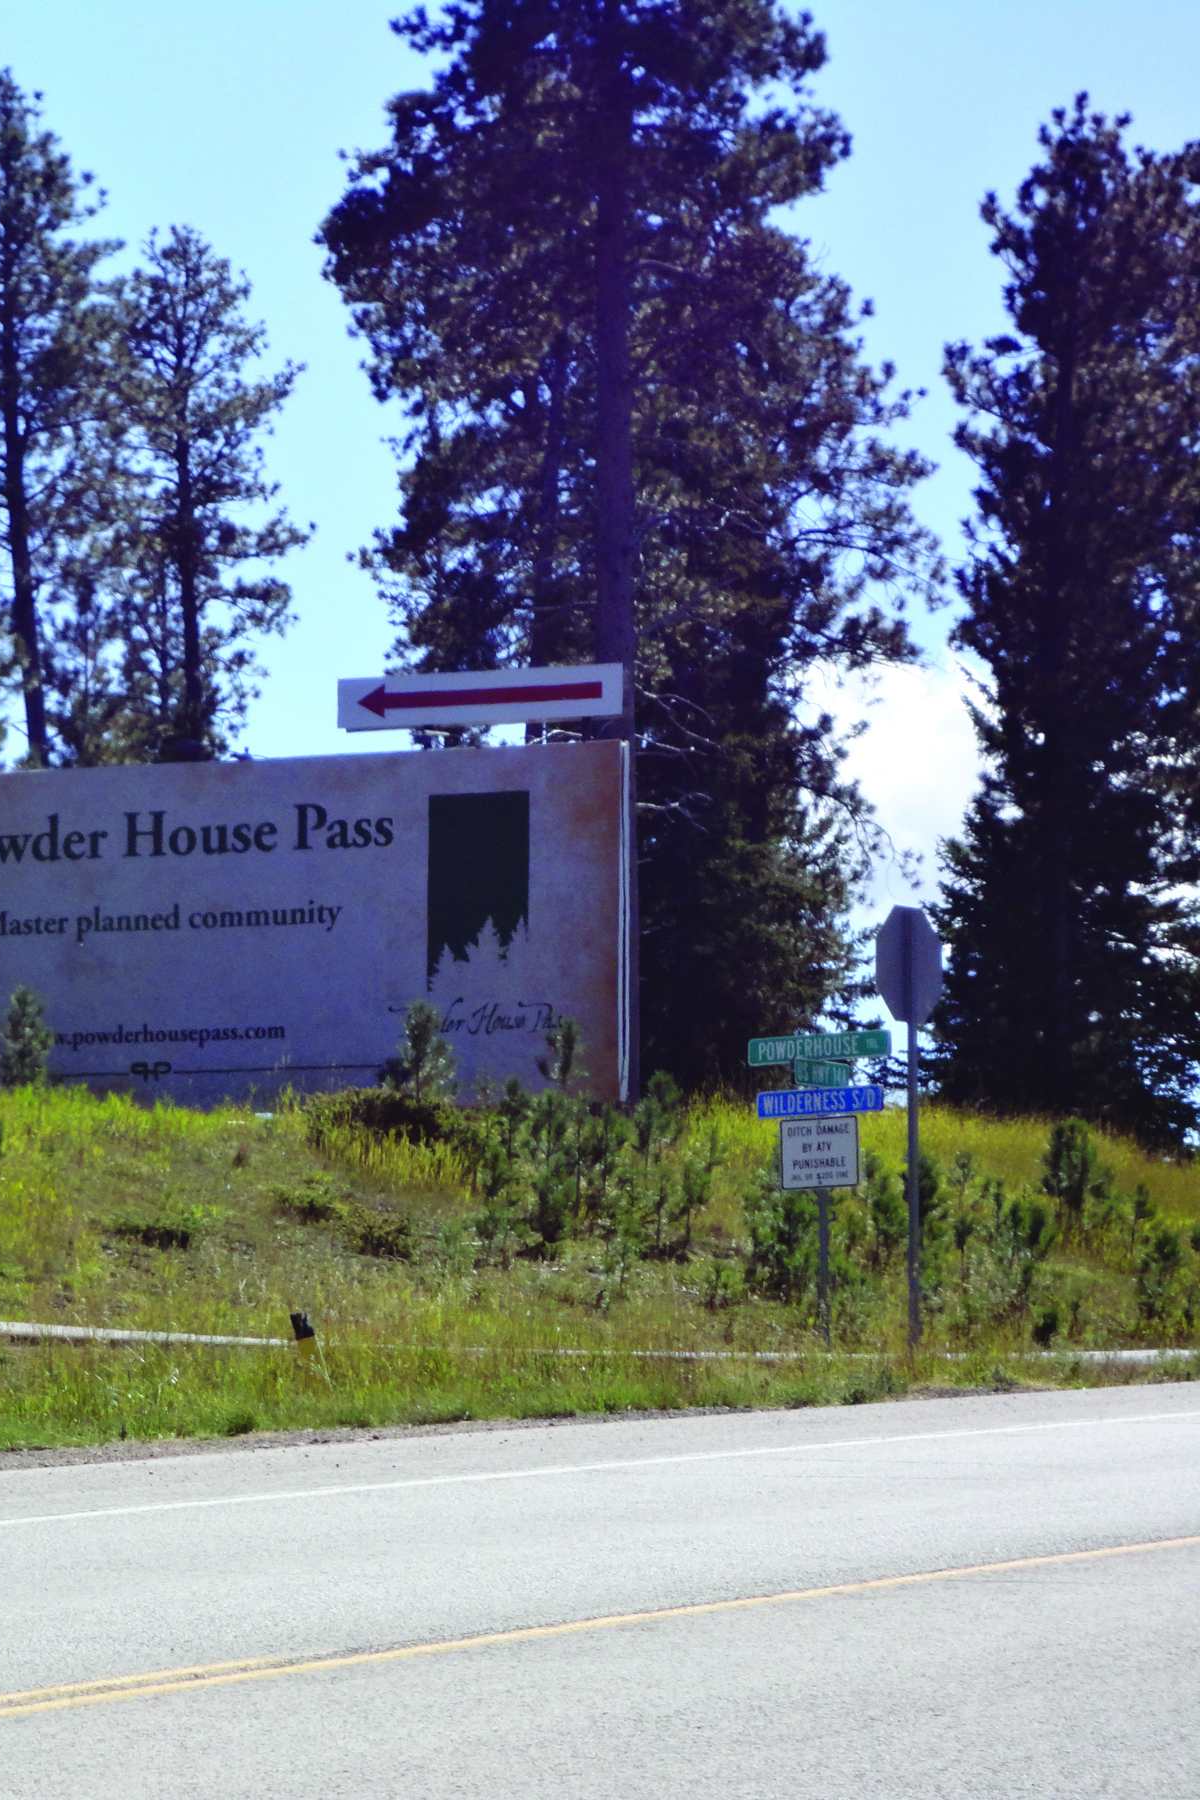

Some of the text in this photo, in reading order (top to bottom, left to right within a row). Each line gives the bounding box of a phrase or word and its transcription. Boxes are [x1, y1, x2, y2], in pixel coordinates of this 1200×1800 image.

[123, 810, 278, 857] House
[293, 803, 395, 851] Pass
[75, 903, 181, 942] planned
[188, 900, 343, 929] community
[758, 1035, 860, 1061] POWDERHOUSE
[763, 1091, 846, 1115] WILDERNESS
[852, 1088, 876, 1109] S/D
[787, 1123, 850, 1138] DITCH DAMAGE
[802, 1141, 832, 1153] BY ATV
[792, 1156, 847, 1170] PUNISHABLE
